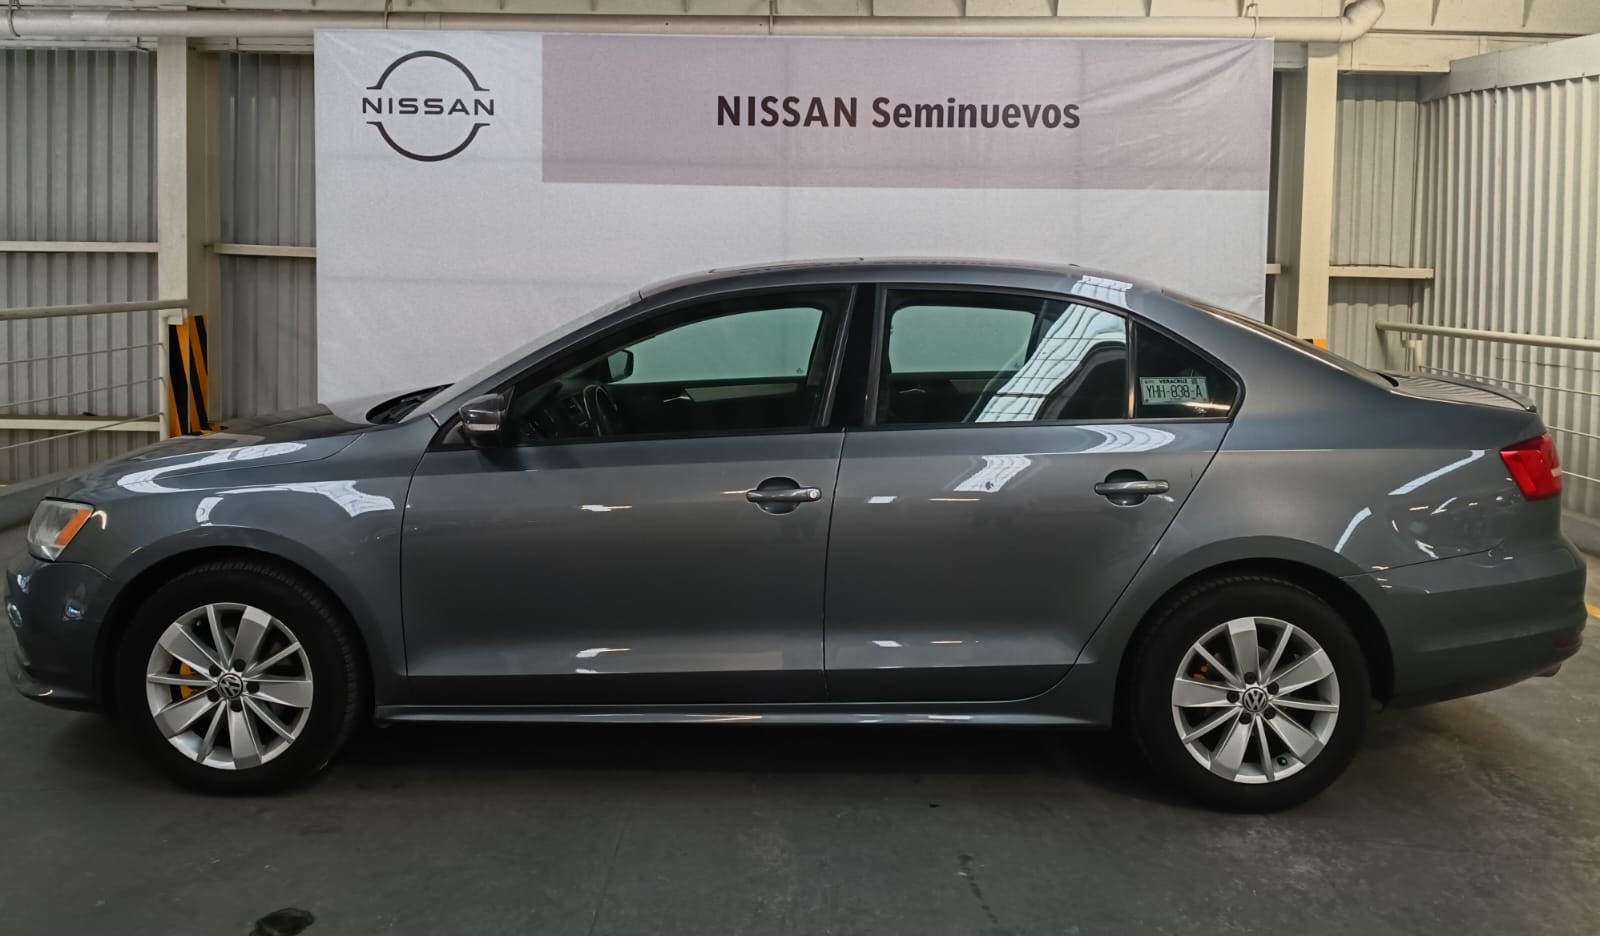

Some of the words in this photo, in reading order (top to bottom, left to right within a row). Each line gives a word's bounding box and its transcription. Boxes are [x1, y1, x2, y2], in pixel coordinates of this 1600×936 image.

[362, 97, 494, 116] NISSAN
[716, 95, 857, 127] NISSAN
[871, 97, 1081, 128] Seminuevos
[1146, 384, 1203, 399] YHH-838-A
